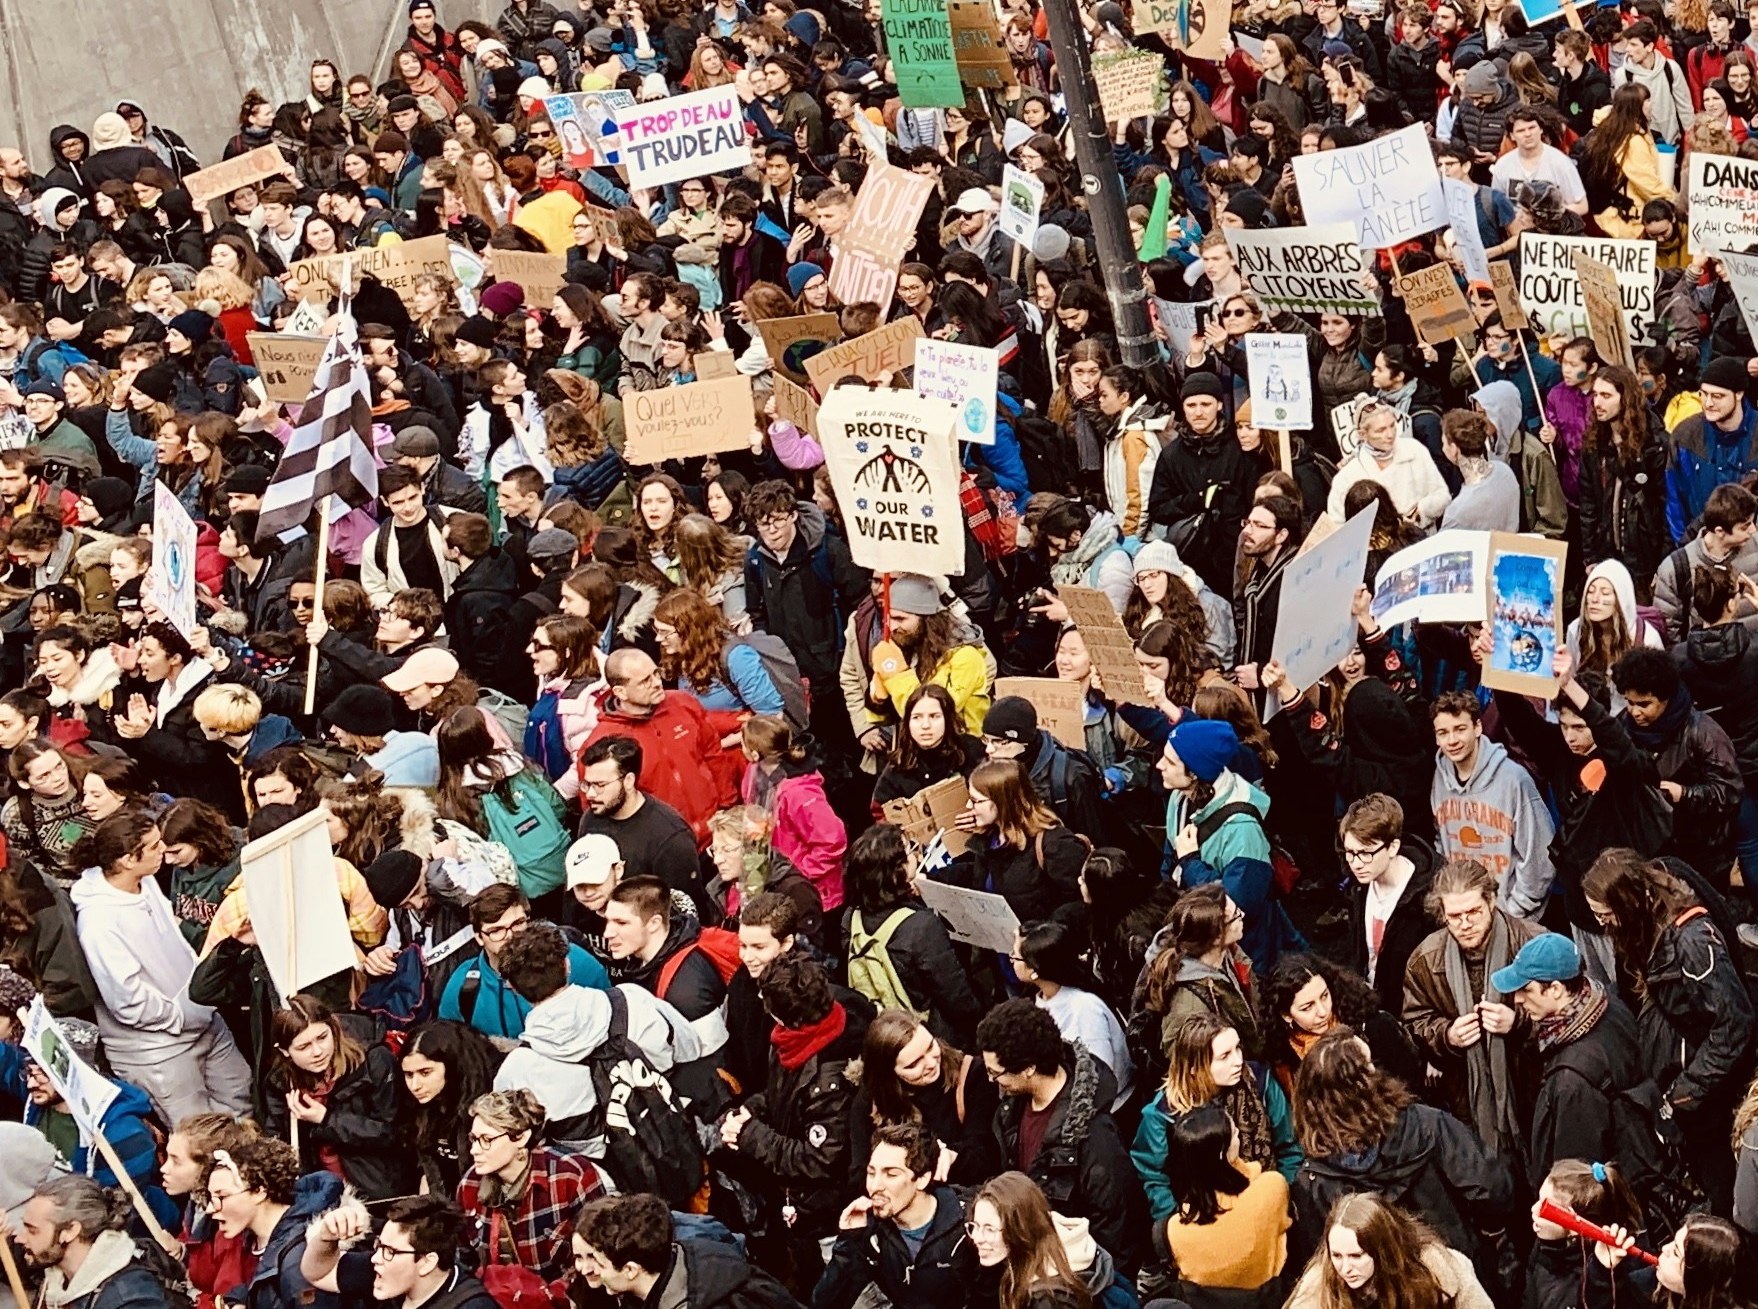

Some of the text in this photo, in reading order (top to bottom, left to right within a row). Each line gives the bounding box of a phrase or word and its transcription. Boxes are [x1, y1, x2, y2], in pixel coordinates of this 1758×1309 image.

[899, 39, 951, 64] A SONNÉ
[620, 112, 678, 142] TROP
[627, 120, 746, 171] TRUDEAU
[1313, 136, 1410, 191] SAUVER
[847, 165, 929, 235] YOUTH
[1357, 182, 1386, 210] LA
[1708, 194, 1746, 210] COMME
[1360, 192, 1434, 246] ANÈTE
[1235, 241, 1362, 276] AUX ARBRES
[1524, 239, 1549, 269] NE
[1600, 243, 1651, 275] FAIRE
[829, 245, 897, 319] UNITED
[1247, 272, 1367, 301] CITOYENS
[1399, 276, 1420, 293] ON
[1523, 270, 1584, 308] COÛTE
[1530, 307, 1647, 343] $ $
[260, 345, 295, 363] Nous
[816, 319, 921, 377] L'INACTION
[843, 345, 903, 382] TUE!
[635, 405, 723, 437] voulez-vous?
[636, 390, 722, 421] Quel VERT
[856, 410, 868, 418] WE
[888, 411, 909, 422] HERE
[910, 415, 922, 424] TO
[844, 422, 929, 446] PROTECT
[875, 501, 909, 516] OUR
[855, 515, 940, 545] WATER
